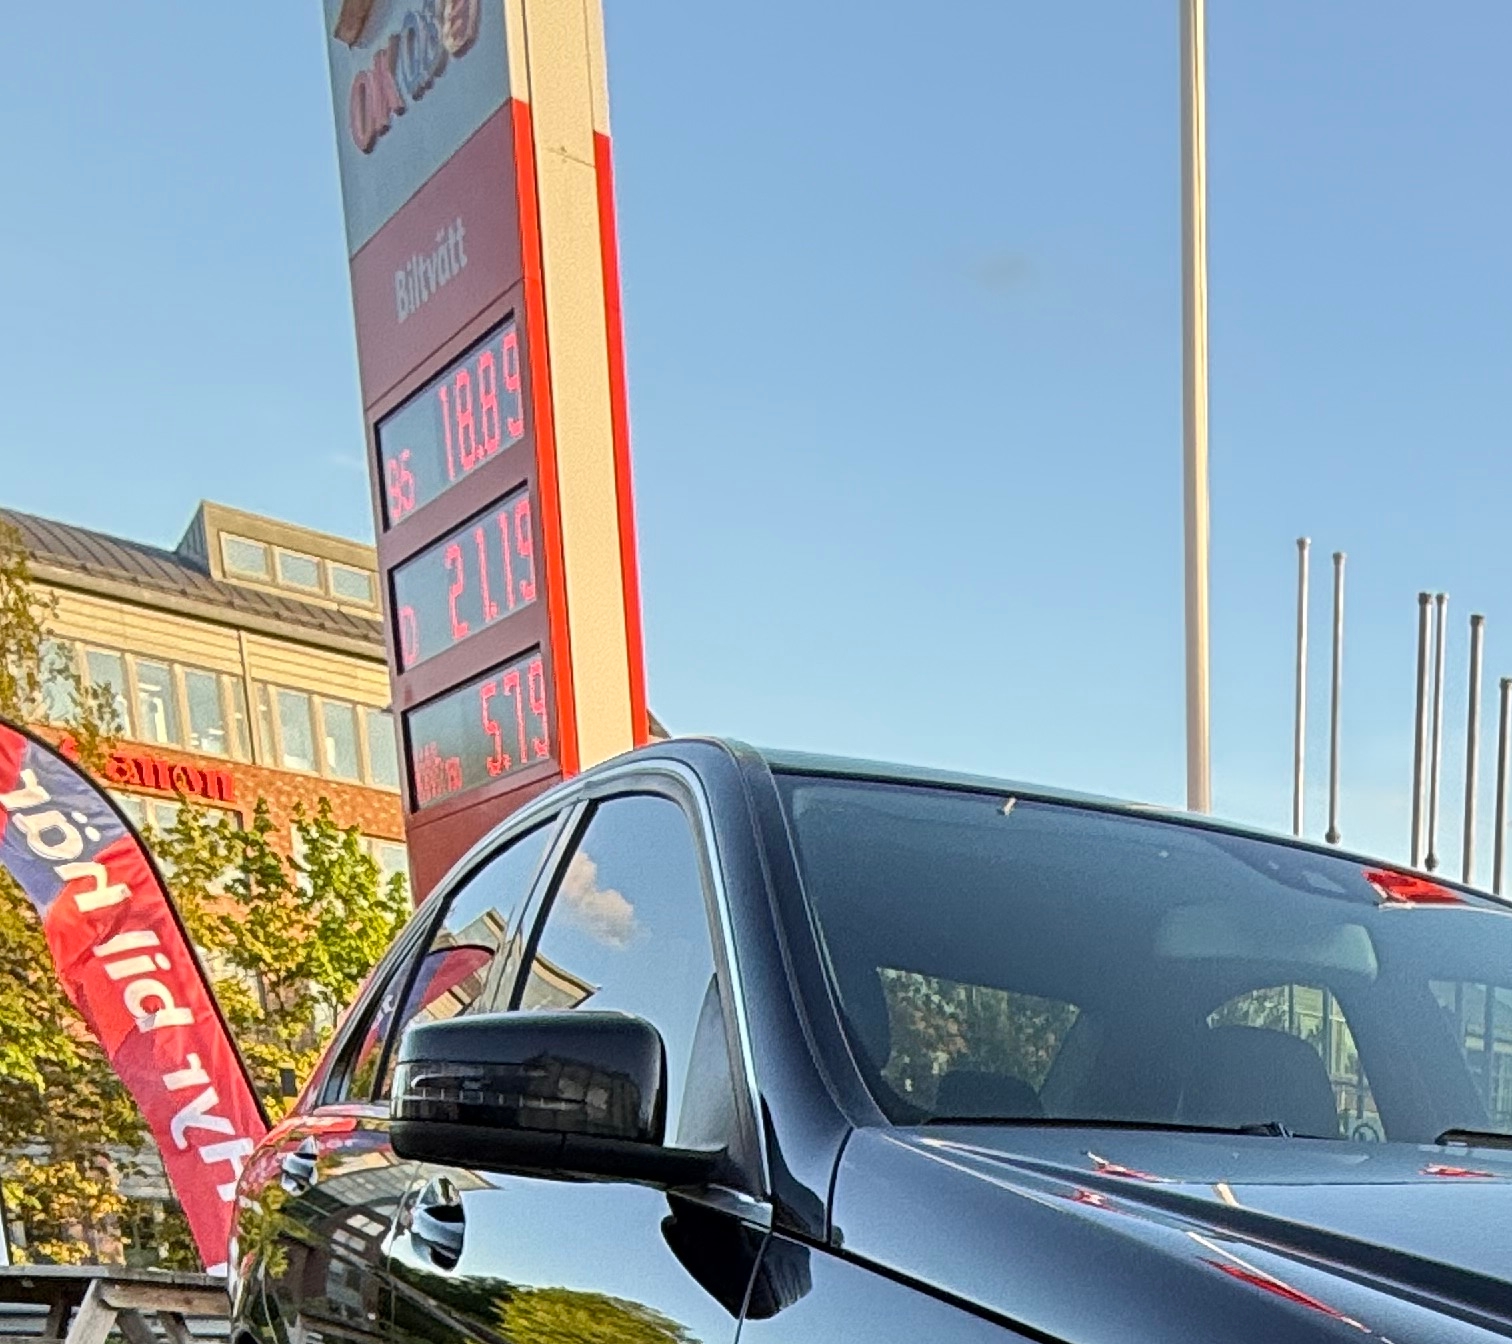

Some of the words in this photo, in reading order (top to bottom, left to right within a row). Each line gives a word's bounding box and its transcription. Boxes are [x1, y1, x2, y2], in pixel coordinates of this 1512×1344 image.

[394, 217, 469, 323] Biltvätt
[438, 331, 525, 481] 18.89
[399, 604, 419, 667] D
[445, 498, 537, 640] 21.19
[479, 657, 550, 777] 5.79
